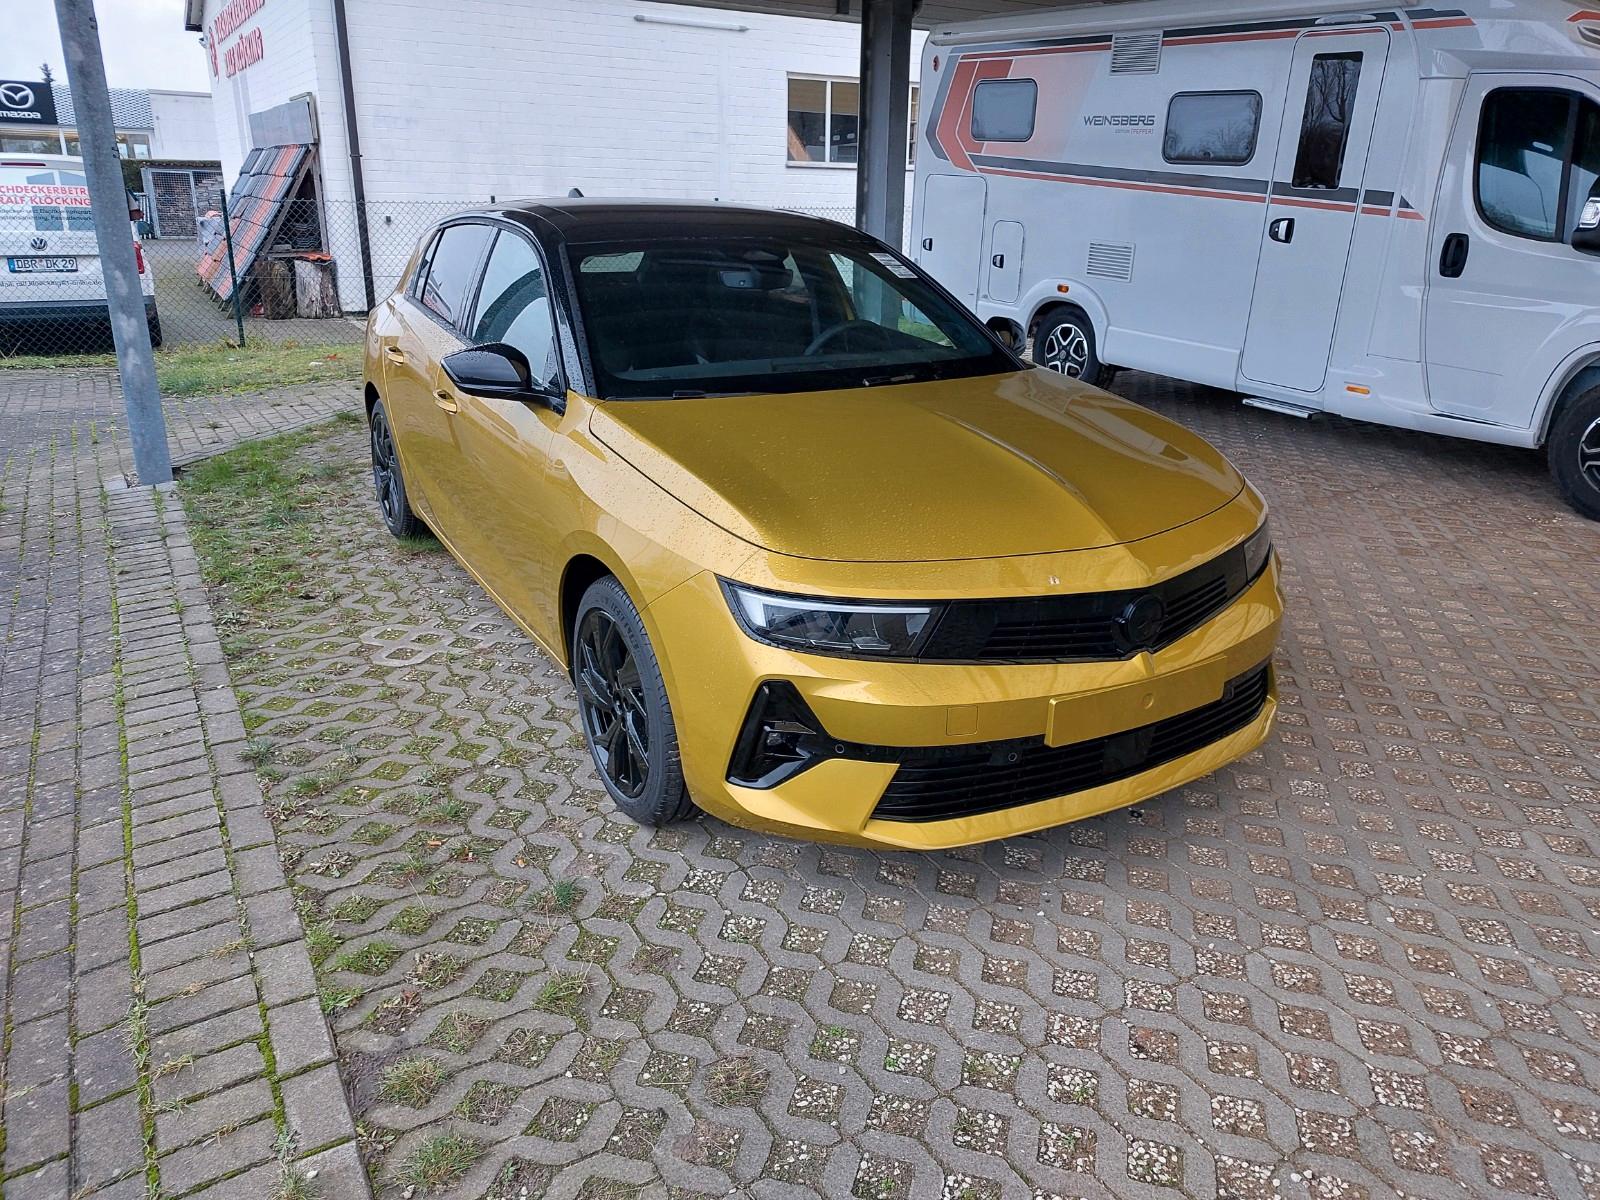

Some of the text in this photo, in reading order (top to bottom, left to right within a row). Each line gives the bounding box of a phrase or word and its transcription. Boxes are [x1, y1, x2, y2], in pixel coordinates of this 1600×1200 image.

[1083, 115, 1156, 126] WEINSBERG
[30, 195, 92, 206] KLÖCKING
[16, 259, 39, 269] DBR
[61, 259, 76, 269] 29
